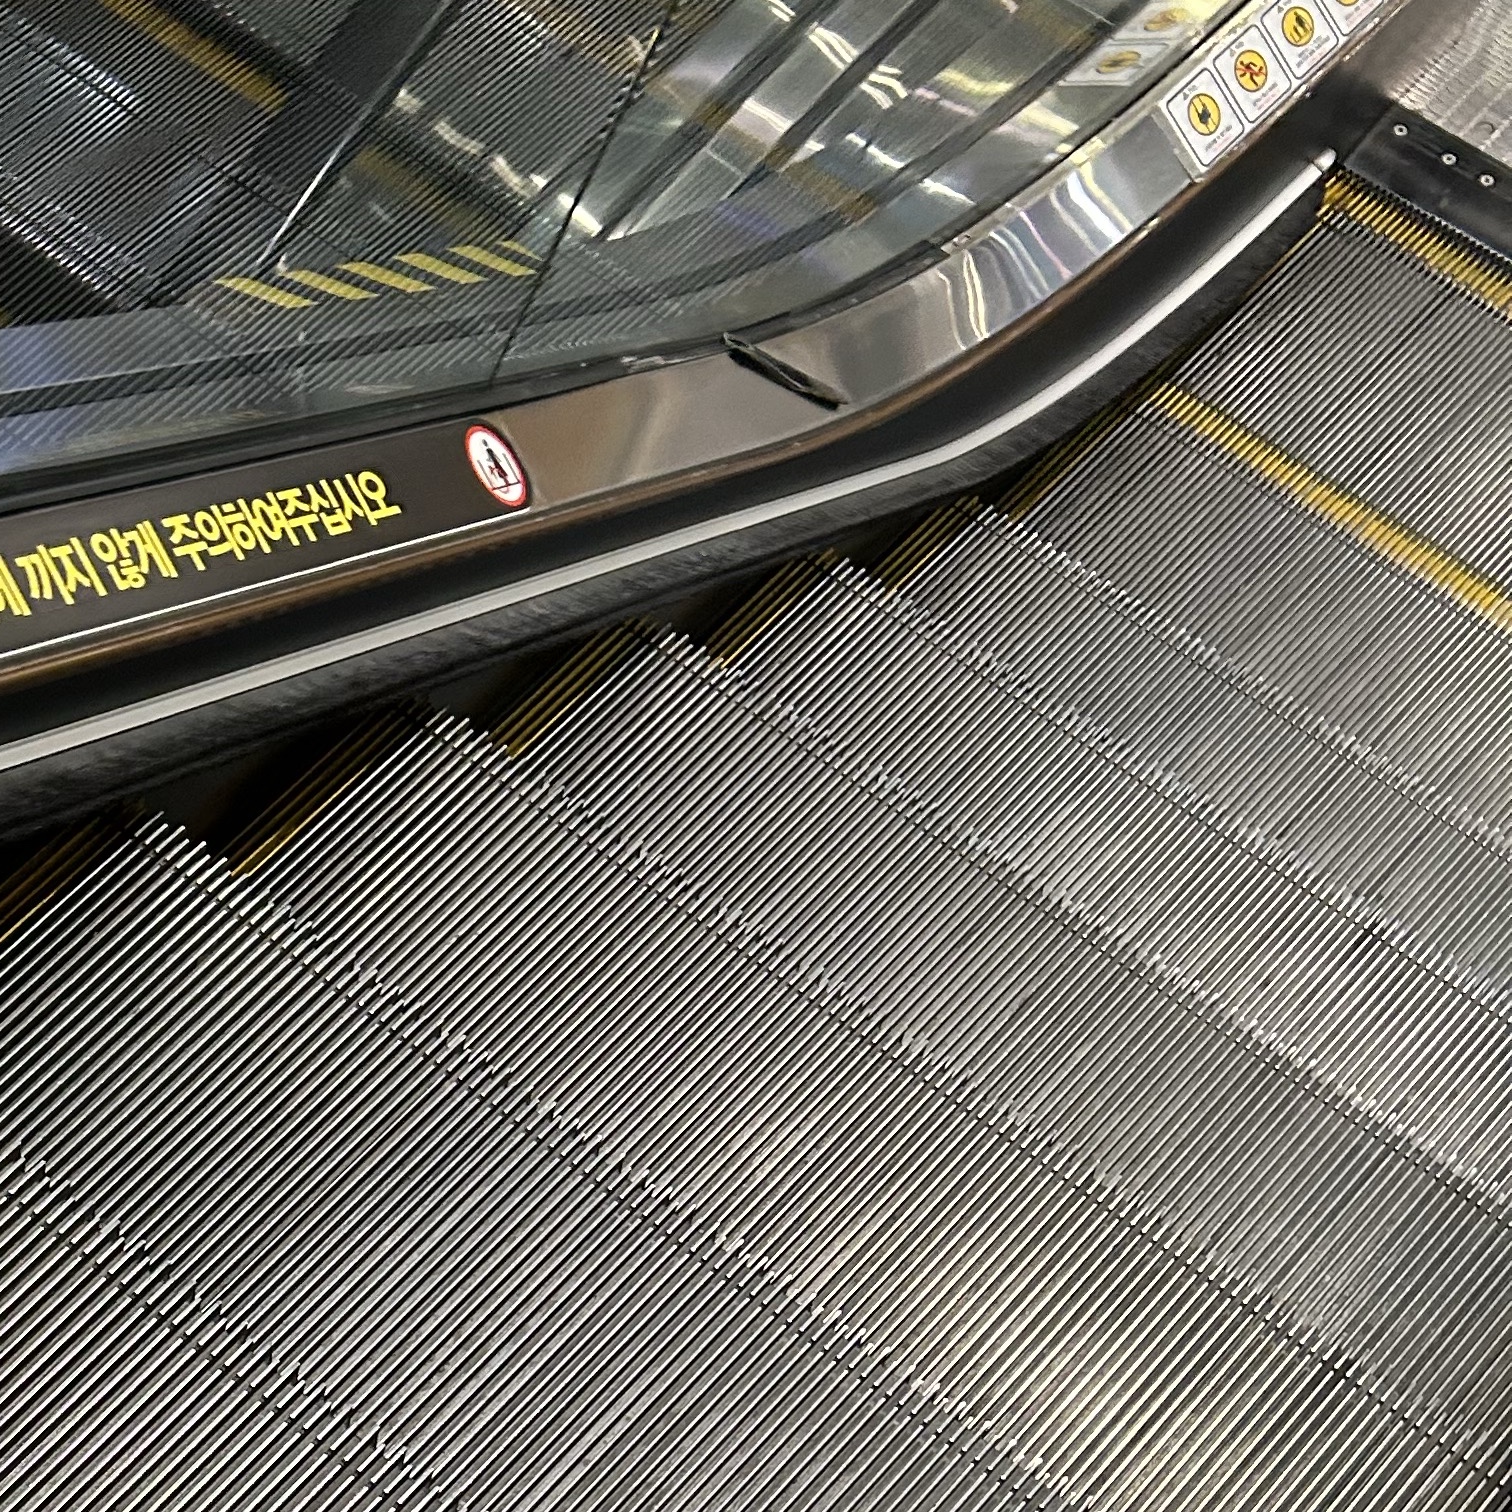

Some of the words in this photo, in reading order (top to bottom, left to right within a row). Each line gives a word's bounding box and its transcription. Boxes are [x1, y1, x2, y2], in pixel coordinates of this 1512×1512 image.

[14, 536, 108, 606] 끼지
[89, 518, 179, 592] 않게
[161, 470, 402, 571] 주의하여주십시오
